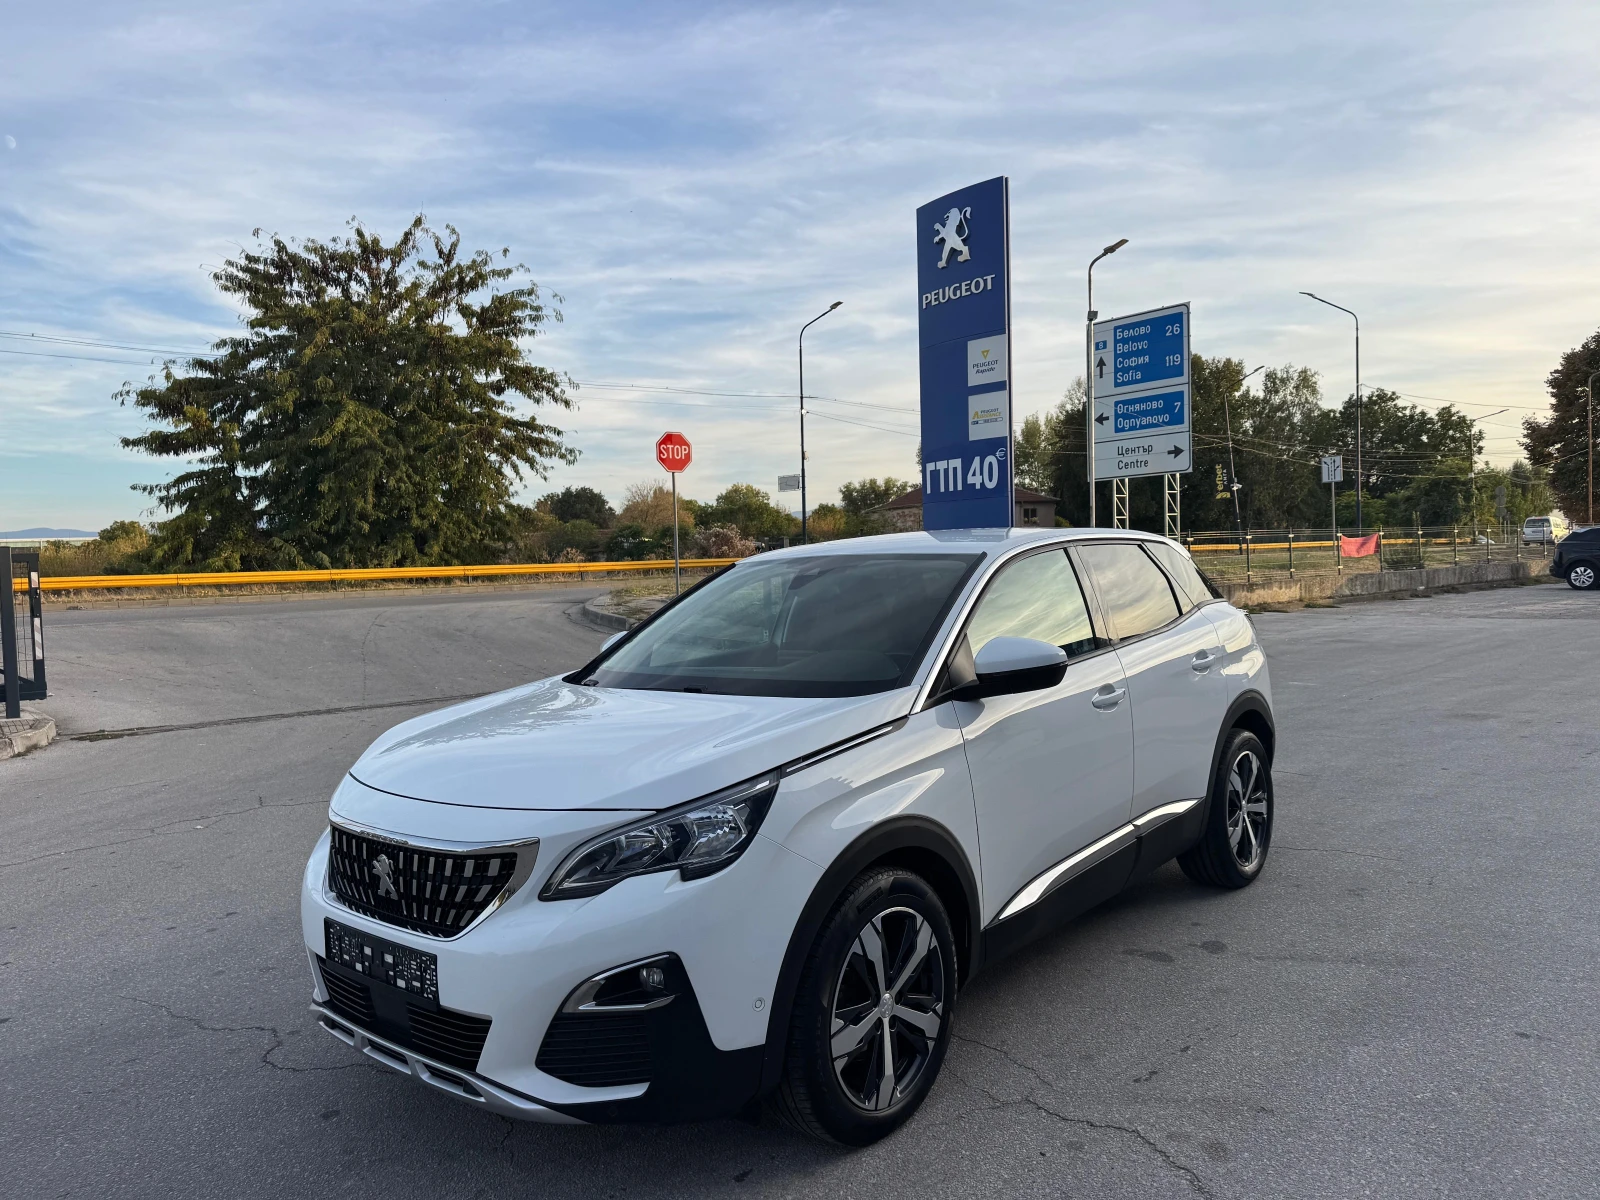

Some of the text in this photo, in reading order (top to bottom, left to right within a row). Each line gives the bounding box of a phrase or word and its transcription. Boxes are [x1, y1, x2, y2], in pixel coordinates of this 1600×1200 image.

[922, 274, 996, 309] PEUGEOT
[1116, 323, 1181, 340] Белово 26
[1098, 341, 1105, 350] 8
[1116, 340, 1149, 354] Belovo
[972, 359, 999, 370] PEUGEOT
[1116, 354, 1181, 368] София 119
[1116, 370, 1142, 383] Sofia
[1117, 399, 1182, 414] Огняново 7
[1117, 413, 1170, 430] Ognyanovo
[660, 444, 689, 460] STOP
[1117, 444, 1153, 457] Център
[1117, 459, 1149, 470] Centre
[925, 457, 963, 494] ГТП
[1215, 463, 1224, 491] efbet
